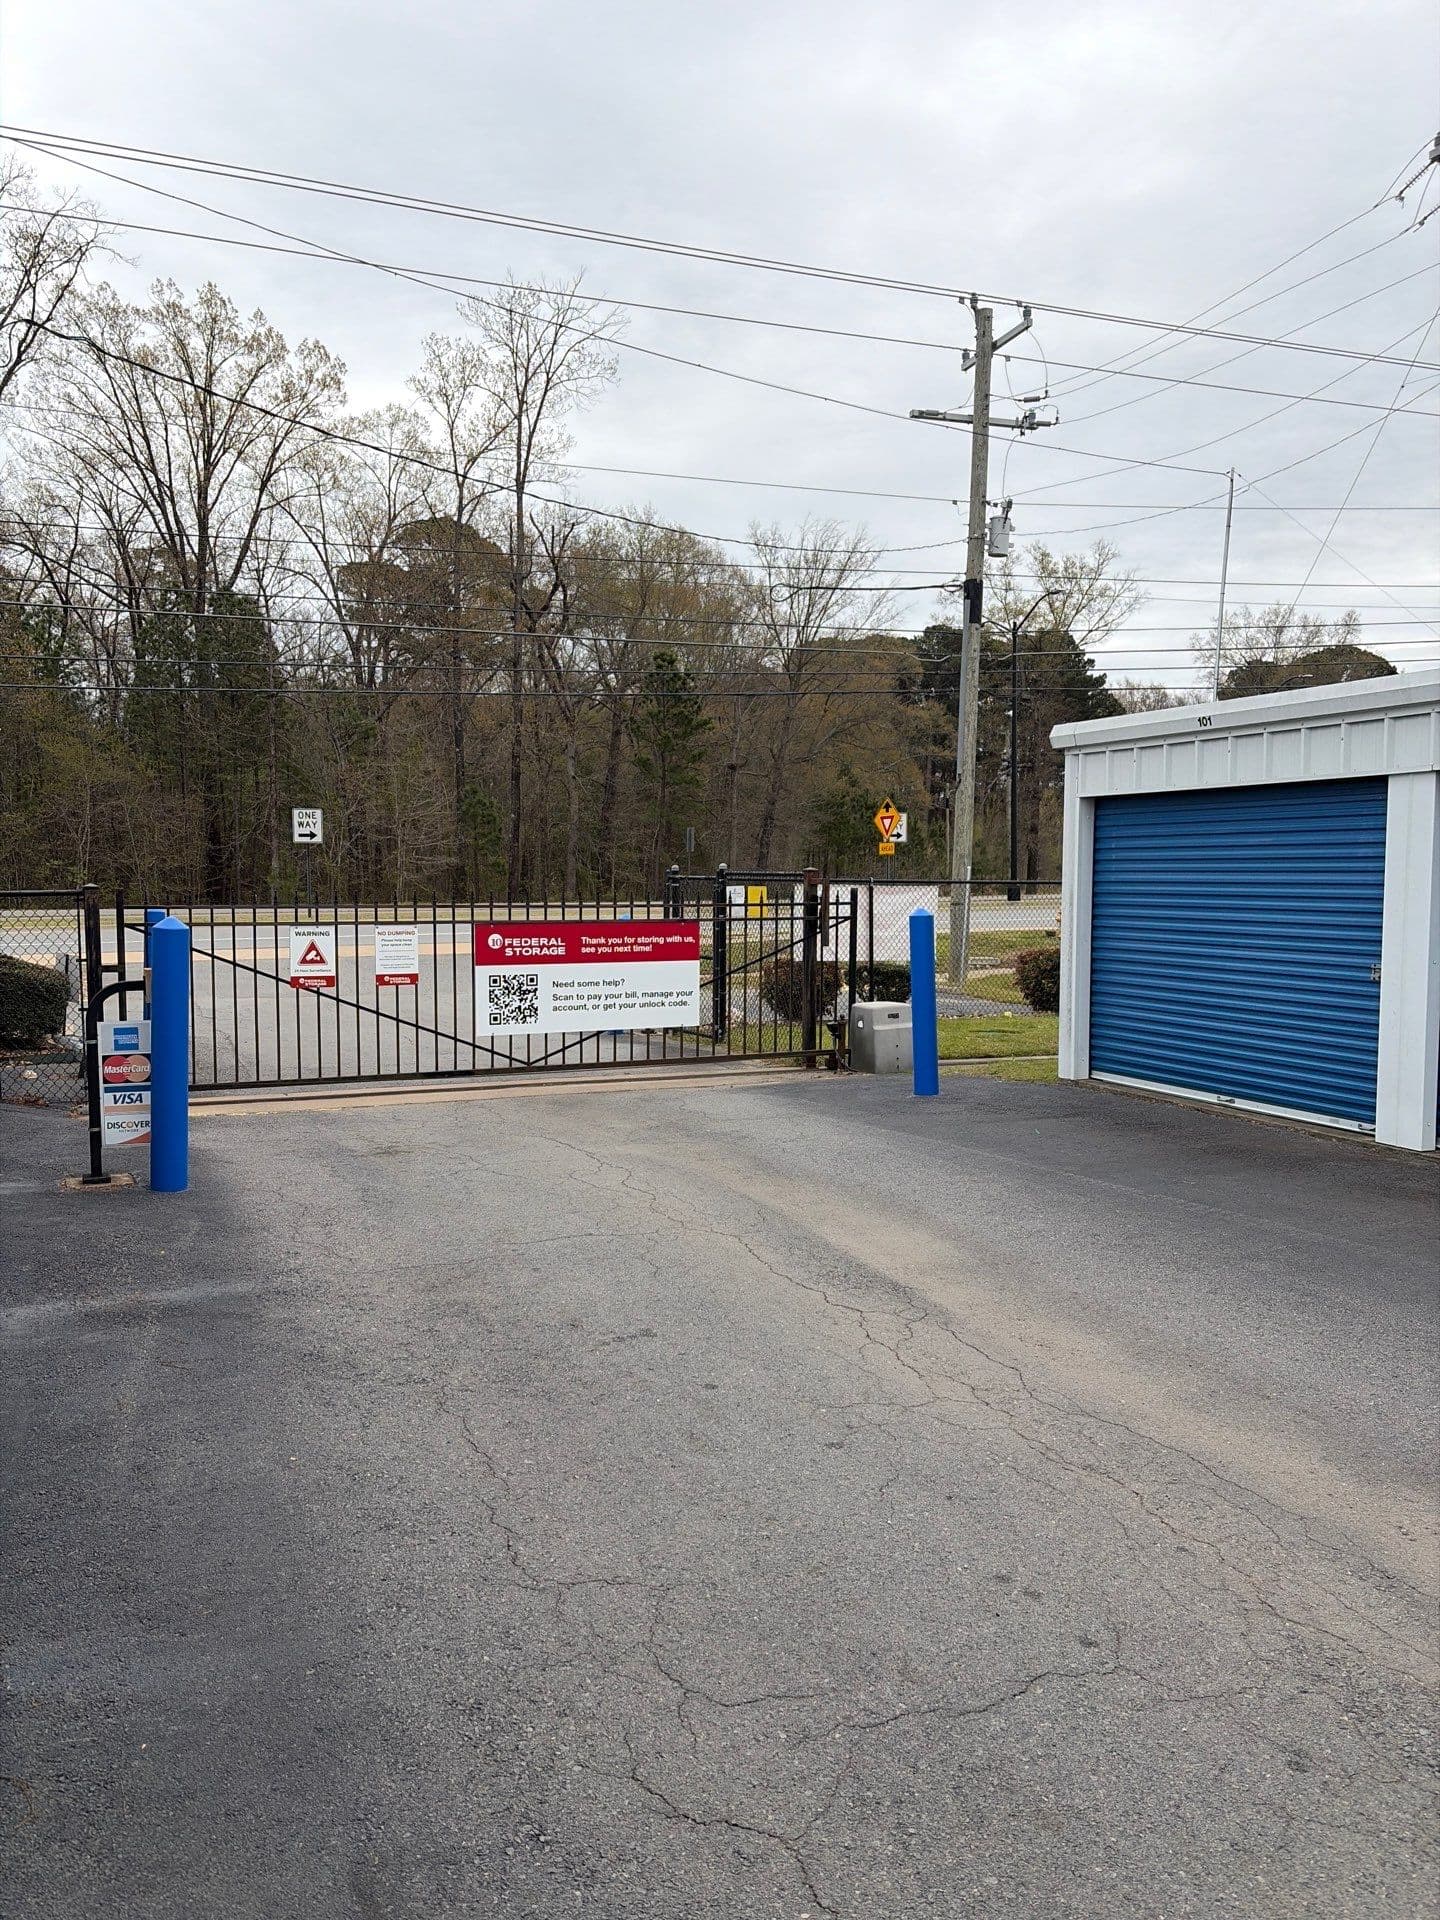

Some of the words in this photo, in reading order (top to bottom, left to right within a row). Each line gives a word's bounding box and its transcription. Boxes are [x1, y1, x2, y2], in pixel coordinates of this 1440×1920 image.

[1197, 715, 1213, 727] 101
[297, 811, 318, 820] ONE
[297, 820, 318, 829] WAY
[504, 937, 566, 946] FEDERAL
[581, 936, 606, 945] Thank
[607, 938, 623, 946] you
[624, 936, 636, 944] for
[637, 936, 665, 945] storing
[665, 935, 683, 943] with
[683, 936, 696, 944] us,
[504, 946, 566, 956] STORAGE
[597, 946, 613, 954] you
[613, 945, 631, 953] next
[633, 944, 653, 952] time!
[552, 980, 575, 988] Need
[577, 980, 601, 988] some
[602, 978, 626, 988] help?
[552, 993, 574, 1002] Scan
[576, 993, 585, 1001] to
[587, 993, 603, 1002] pay
[604, 992, 623, 1001] your
[625, 991, 640, 1000] bill,
[641, 990, 674, 999] manage
[675, 989, 694, 998] your
[552, 1003, 590, 1012] account,
[591, 1003, 601, 1011] or
[602, 1002, 617, 1012] get
[618, 1001, 637, 1011] your
[638, 999, 666, 1008] unlock
[668, 999, 690, 1007] code.
[104, 1064, 150, 1074] MasterCard
[112, 1093, 144, 1105] VISA
[106, 1120, 151, 1129] DISCOVER
